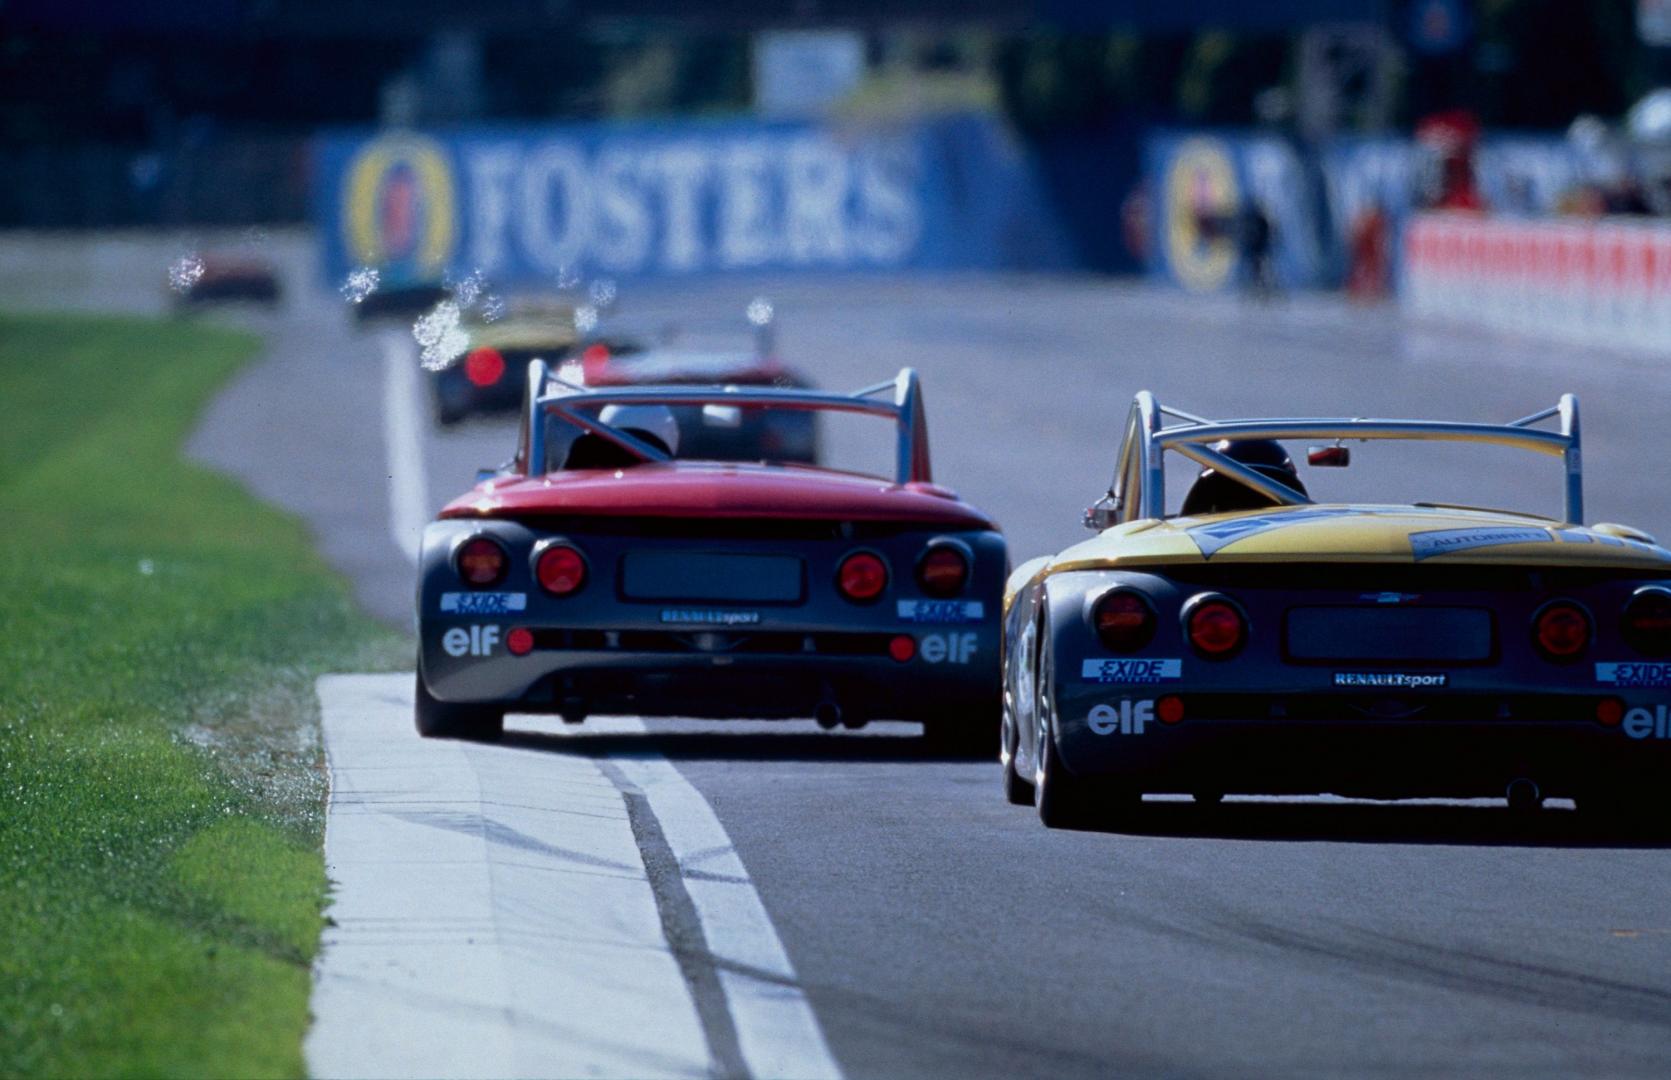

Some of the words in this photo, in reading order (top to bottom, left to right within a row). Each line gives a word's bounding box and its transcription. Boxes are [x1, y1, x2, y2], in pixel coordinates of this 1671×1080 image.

[441, 624, 500, 656] elf
[920, 632, 978, 664] elf
[1100, 660, 1165, 677] EXIDE
[1087, 700, 1155, 735] elf
[1622, 704, 1671, 740] el
